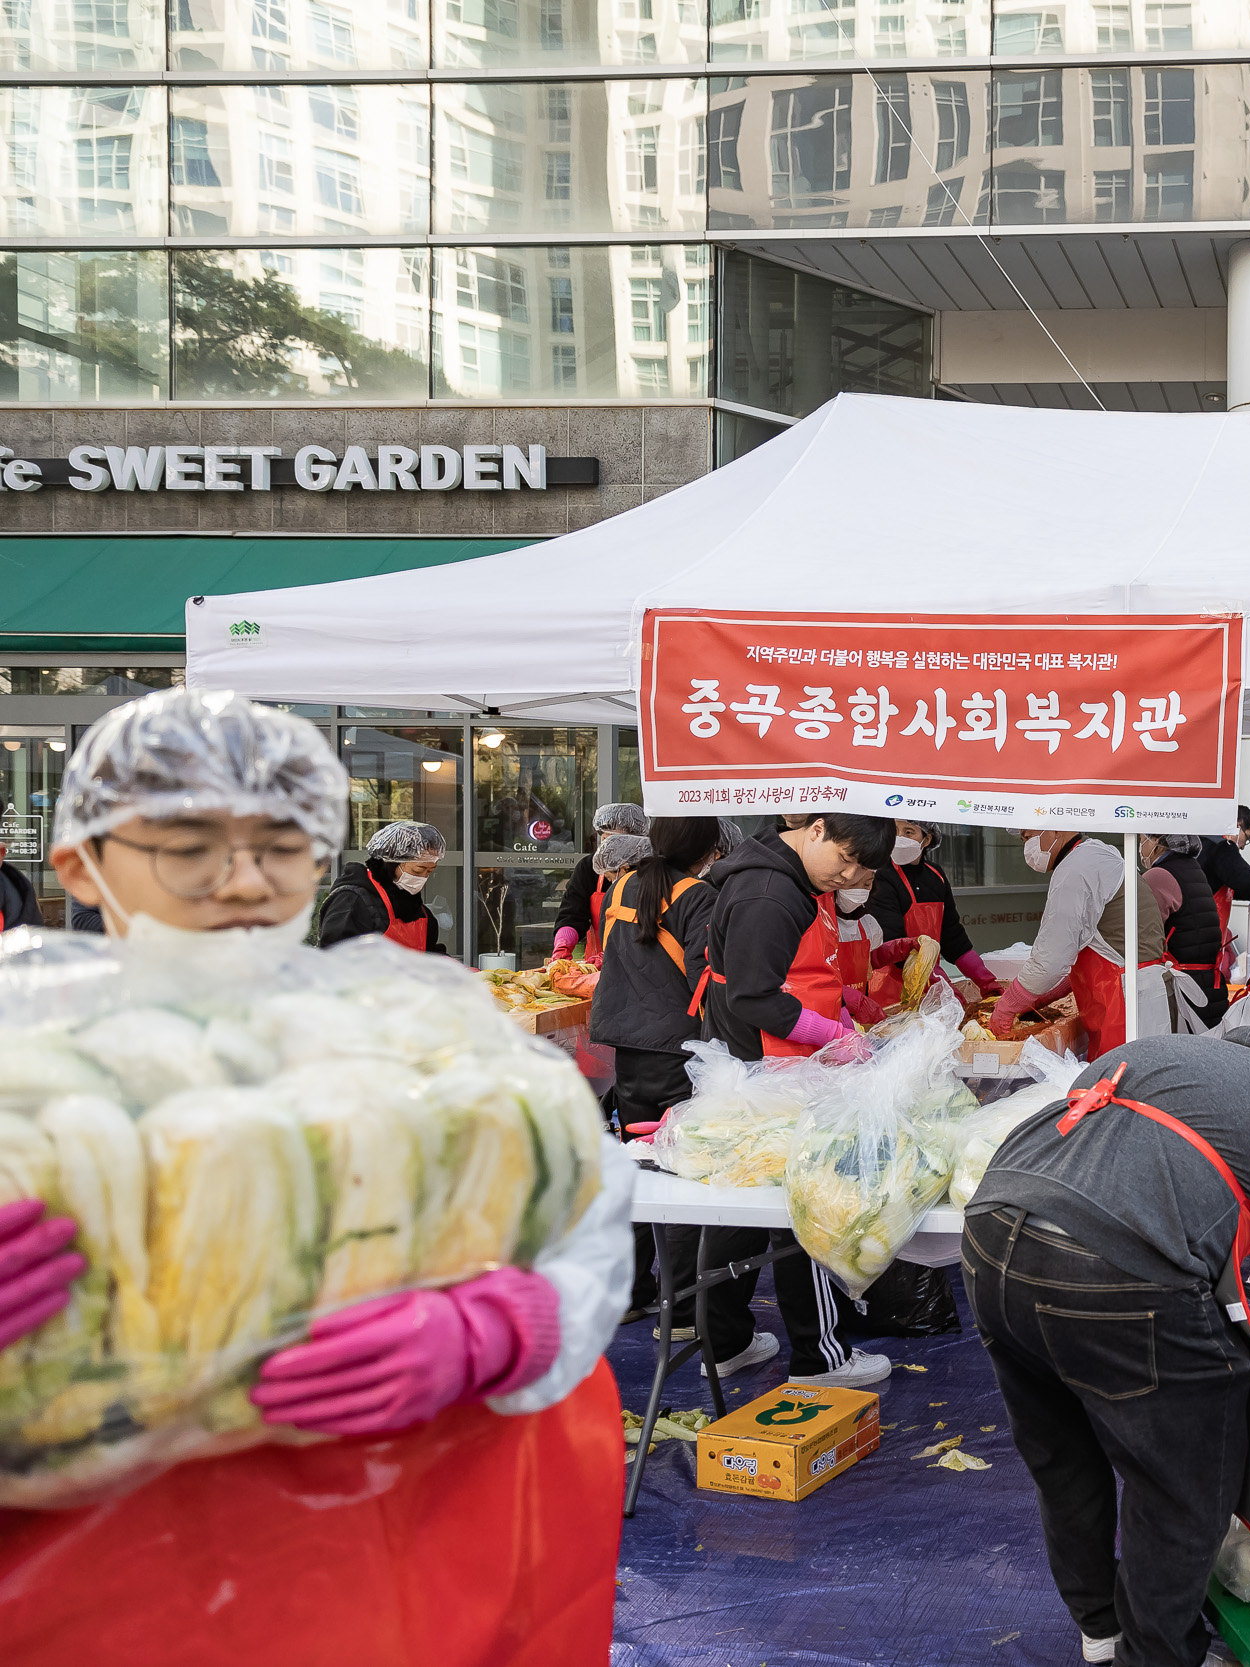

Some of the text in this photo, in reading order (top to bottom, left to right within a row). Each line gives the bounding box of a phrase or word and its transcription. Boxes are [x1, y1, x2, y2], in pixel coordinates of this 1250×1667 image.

[69, 445, 281, 491] SWEET
[294, 444, 547, 492] GARDEN
[747, 645, 1118, 671] 지역주민과 더불어 행복을 실현하는 대한민국 대표 복지관!
[681, 677, 1188, 755] 중곡종합사회복지관
[678, 785, 848, 805] 2023 제1회 광진 사랑의 김장축제
[906, 798, 937, 808] 광진구
[973, 803, 1015, 814] 광진복지재단
[513, 842, 538, 852] Cafe
